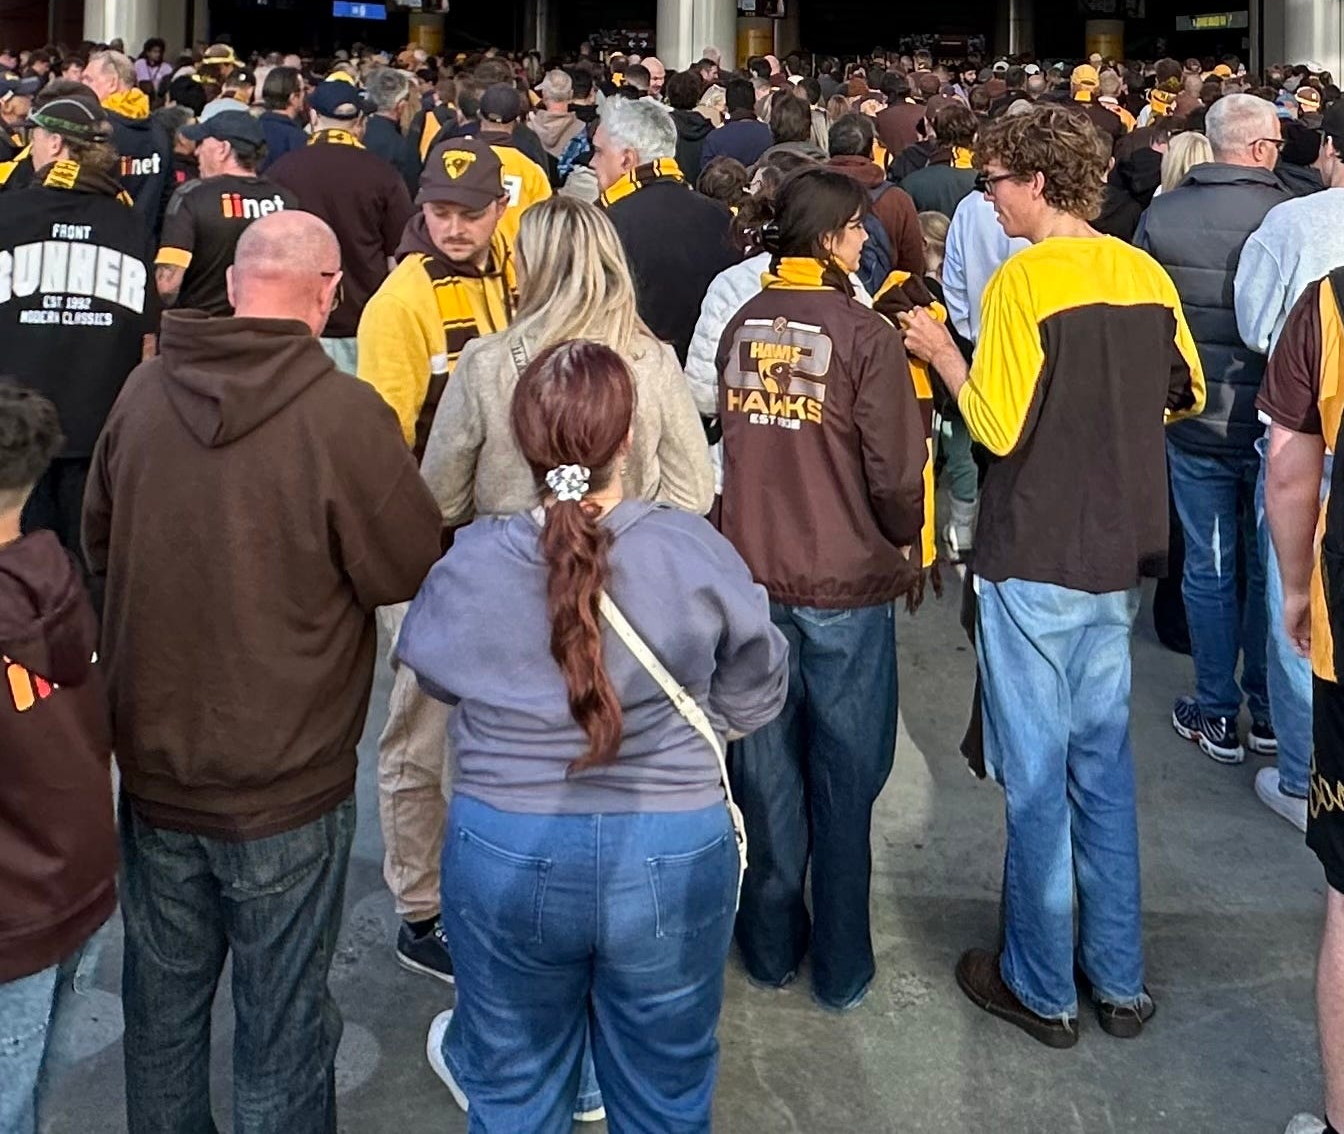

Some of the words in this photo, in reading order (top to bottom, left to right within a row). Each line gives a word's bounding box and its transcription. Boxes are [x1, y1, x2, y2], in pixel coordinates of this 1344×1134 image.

[121, 153, 161, 176] iinet
[220, 193, 285, 218] iinet
[52, 223, 92, 239] FRONT
[61, 311, 113, 326] CLASSICS
[750, 341, 802, 364] HAWKS
[727, 389, 822, 424] HAWKS
[750, 413, 776, 425] EST
